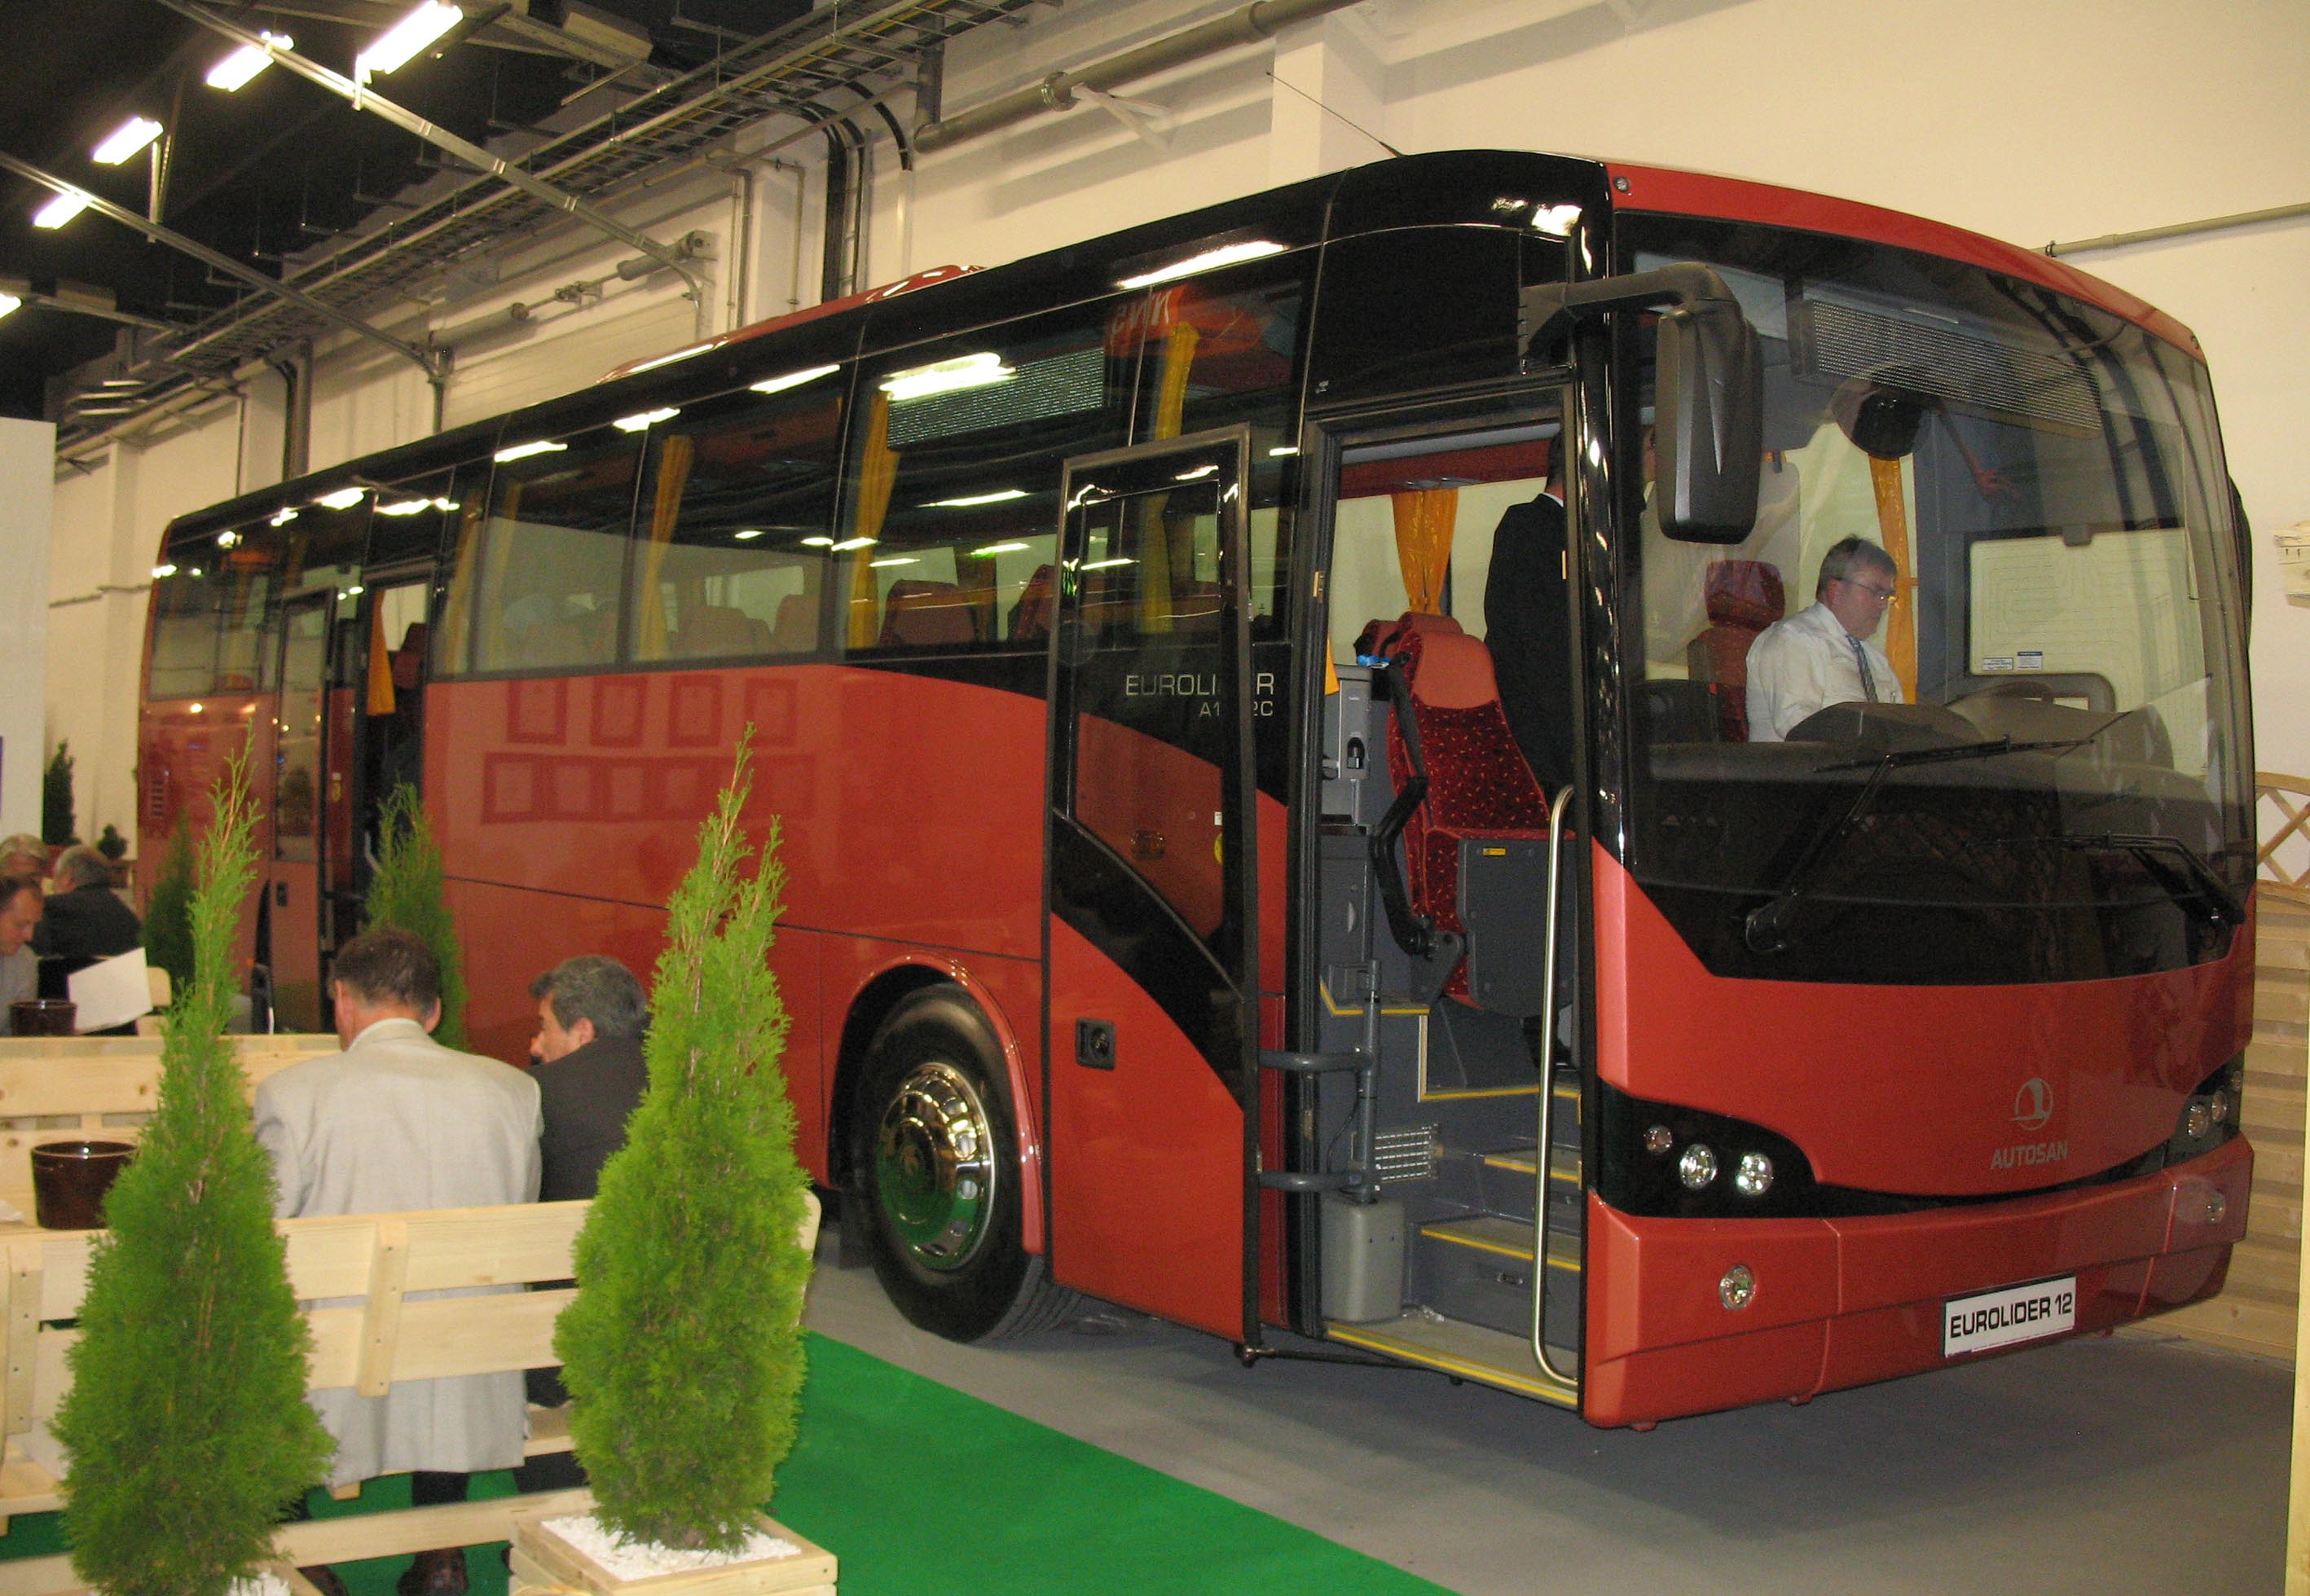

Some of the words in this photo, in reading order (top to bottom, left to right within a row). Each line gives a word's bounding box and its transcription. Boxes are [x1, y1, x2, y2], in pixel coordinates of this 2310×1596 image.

[1126, 673, 1274, 695] EUROLIR
[1991, 1141, 2068, 1169] AUTOSAN
[1951, 1297, 2050, 1338] EUROLIDER
[2055, 1291, 2073, 1315] 12
